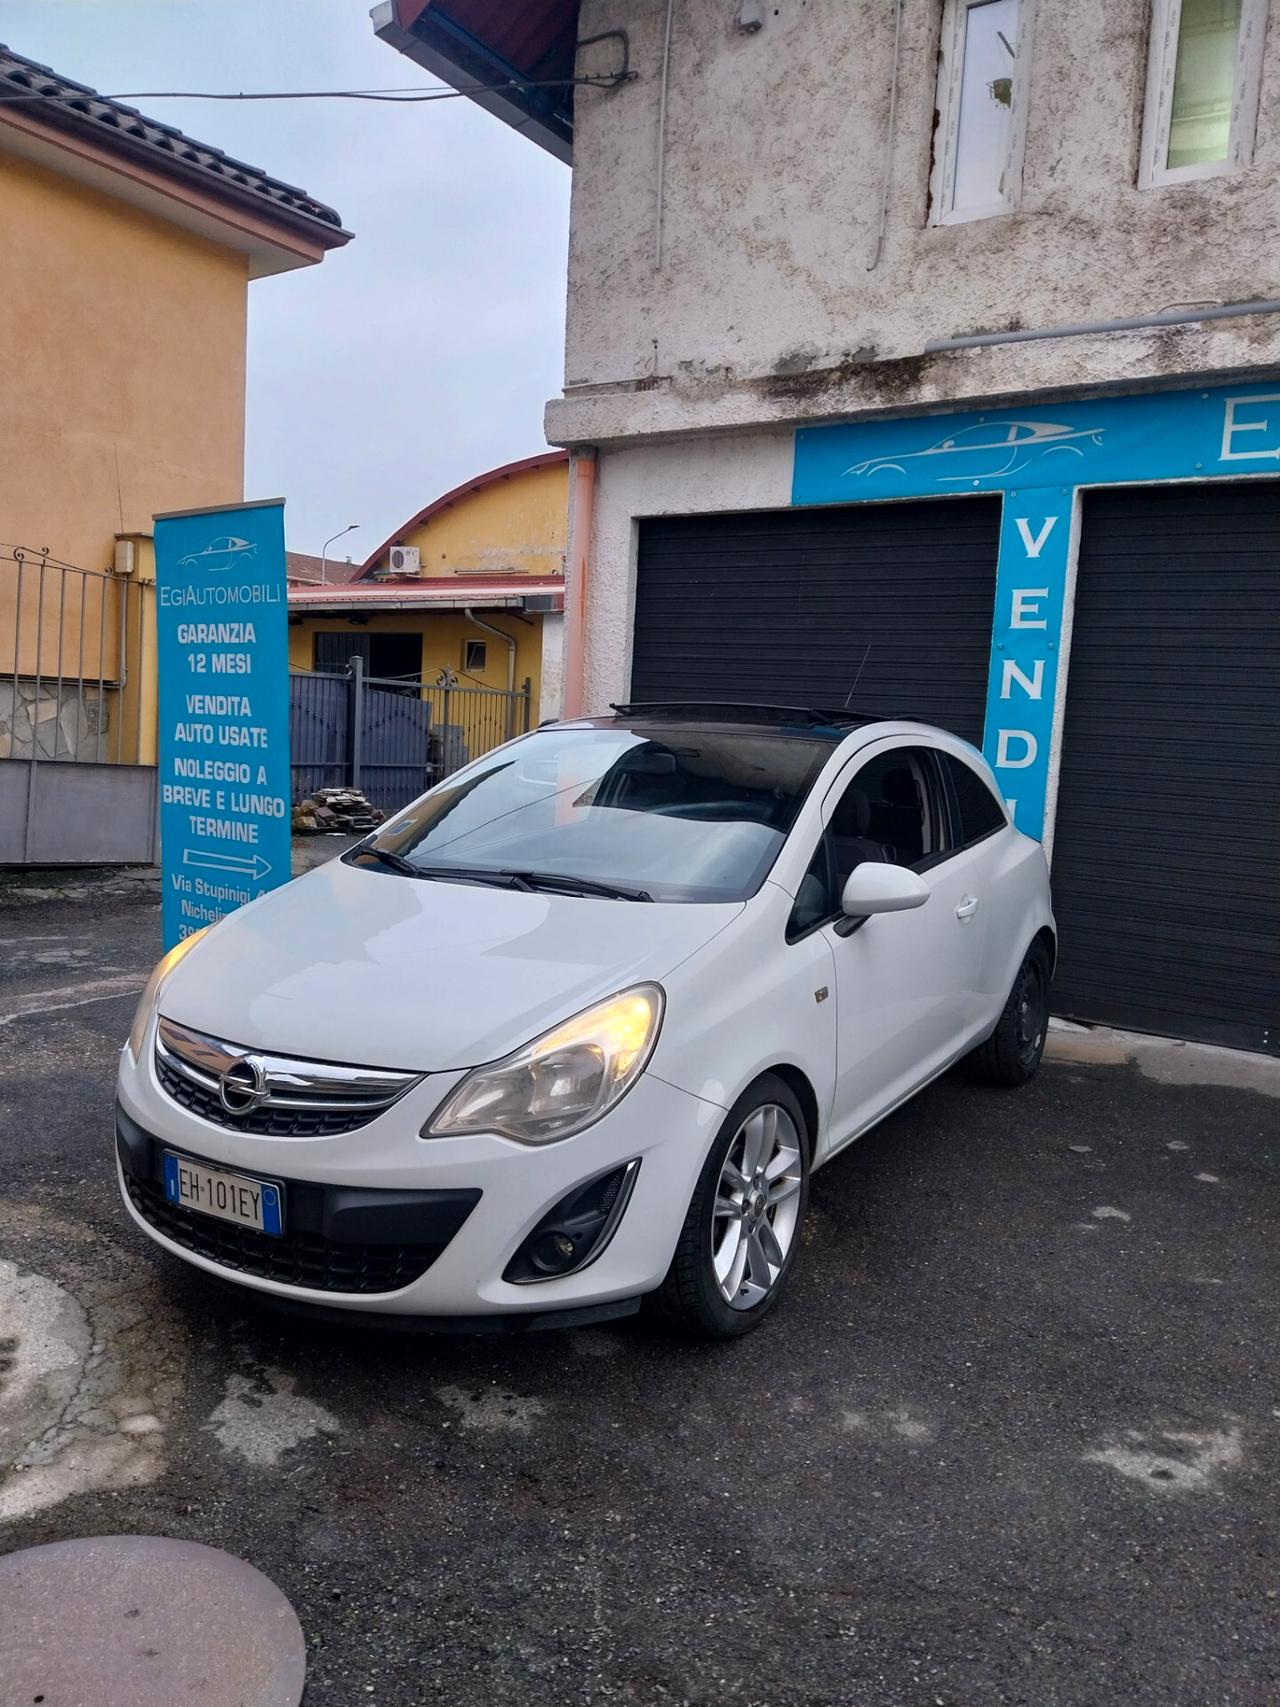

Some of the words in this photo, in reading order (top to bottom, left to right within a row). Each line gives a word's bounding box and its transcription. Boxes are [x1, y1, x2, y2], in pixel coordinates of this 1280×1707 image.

[177, 623, 256, 644] GARANZIA
[188, 653, 206, 673] 12
[212, 654, 251, 674] MESI
[185, 694, 252, 717] VENDITA
[174, 722, 214, 744] AUTO
[218, 726, 268, 748] USATE
[174, 757, 250, 785] NOLEGGIO
[256, 765, 267, 786] A
[162, 784, 211, 809] BREVE
[216, 791, 225, 810] E
[231, 792, 285, 818] LUNGO
[189, 815, 259, 844] TERMINE
[171, 873, 192, 892] Via
